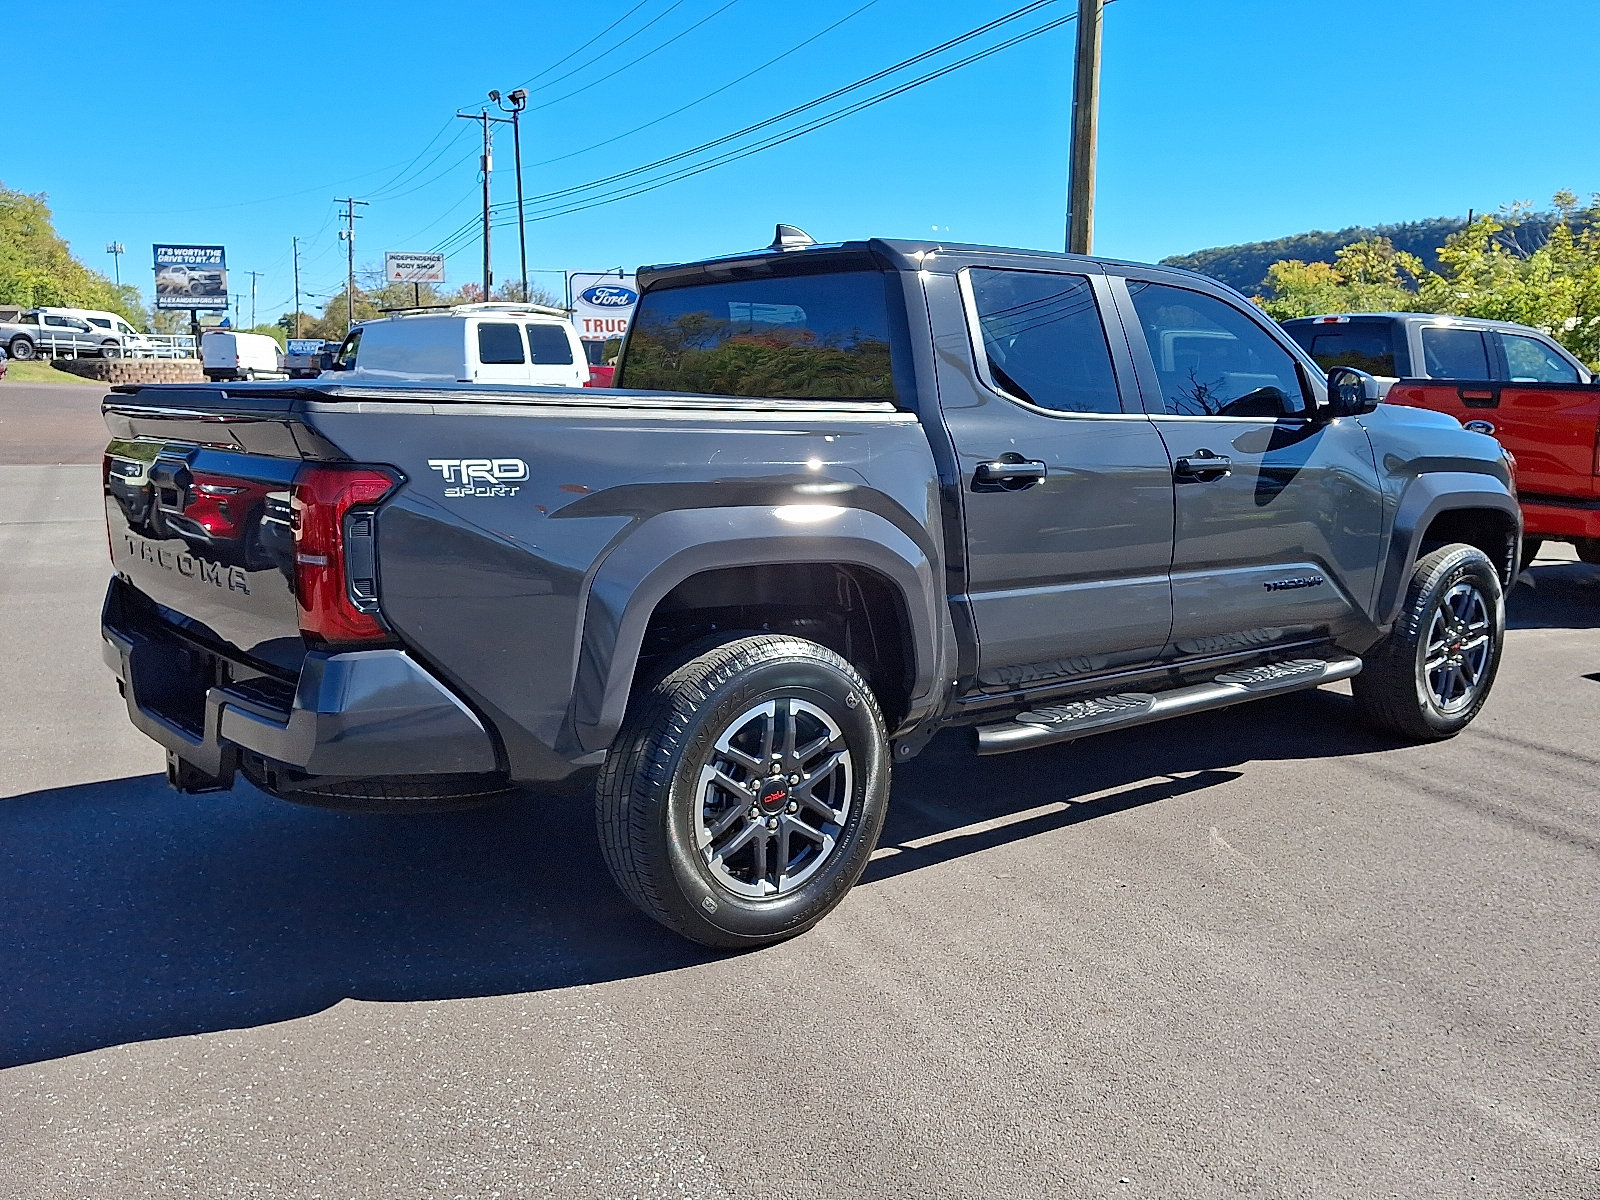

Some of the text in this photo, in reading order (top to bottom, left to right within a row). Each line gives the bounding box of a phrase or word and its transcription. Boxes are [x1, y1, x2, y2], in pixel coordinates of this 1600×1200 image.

[157, 247, 174, 256] IT'S
[592, 288, 629, 305] Ford
[582, 319, 627, 333] TRUC
[428, 458, 528, 484] TRD
[444, 486, 520, 498] SPORT
[124, 534, 250, 596] TACOMA
[1263, 576, 1324, 592] TACOMA
